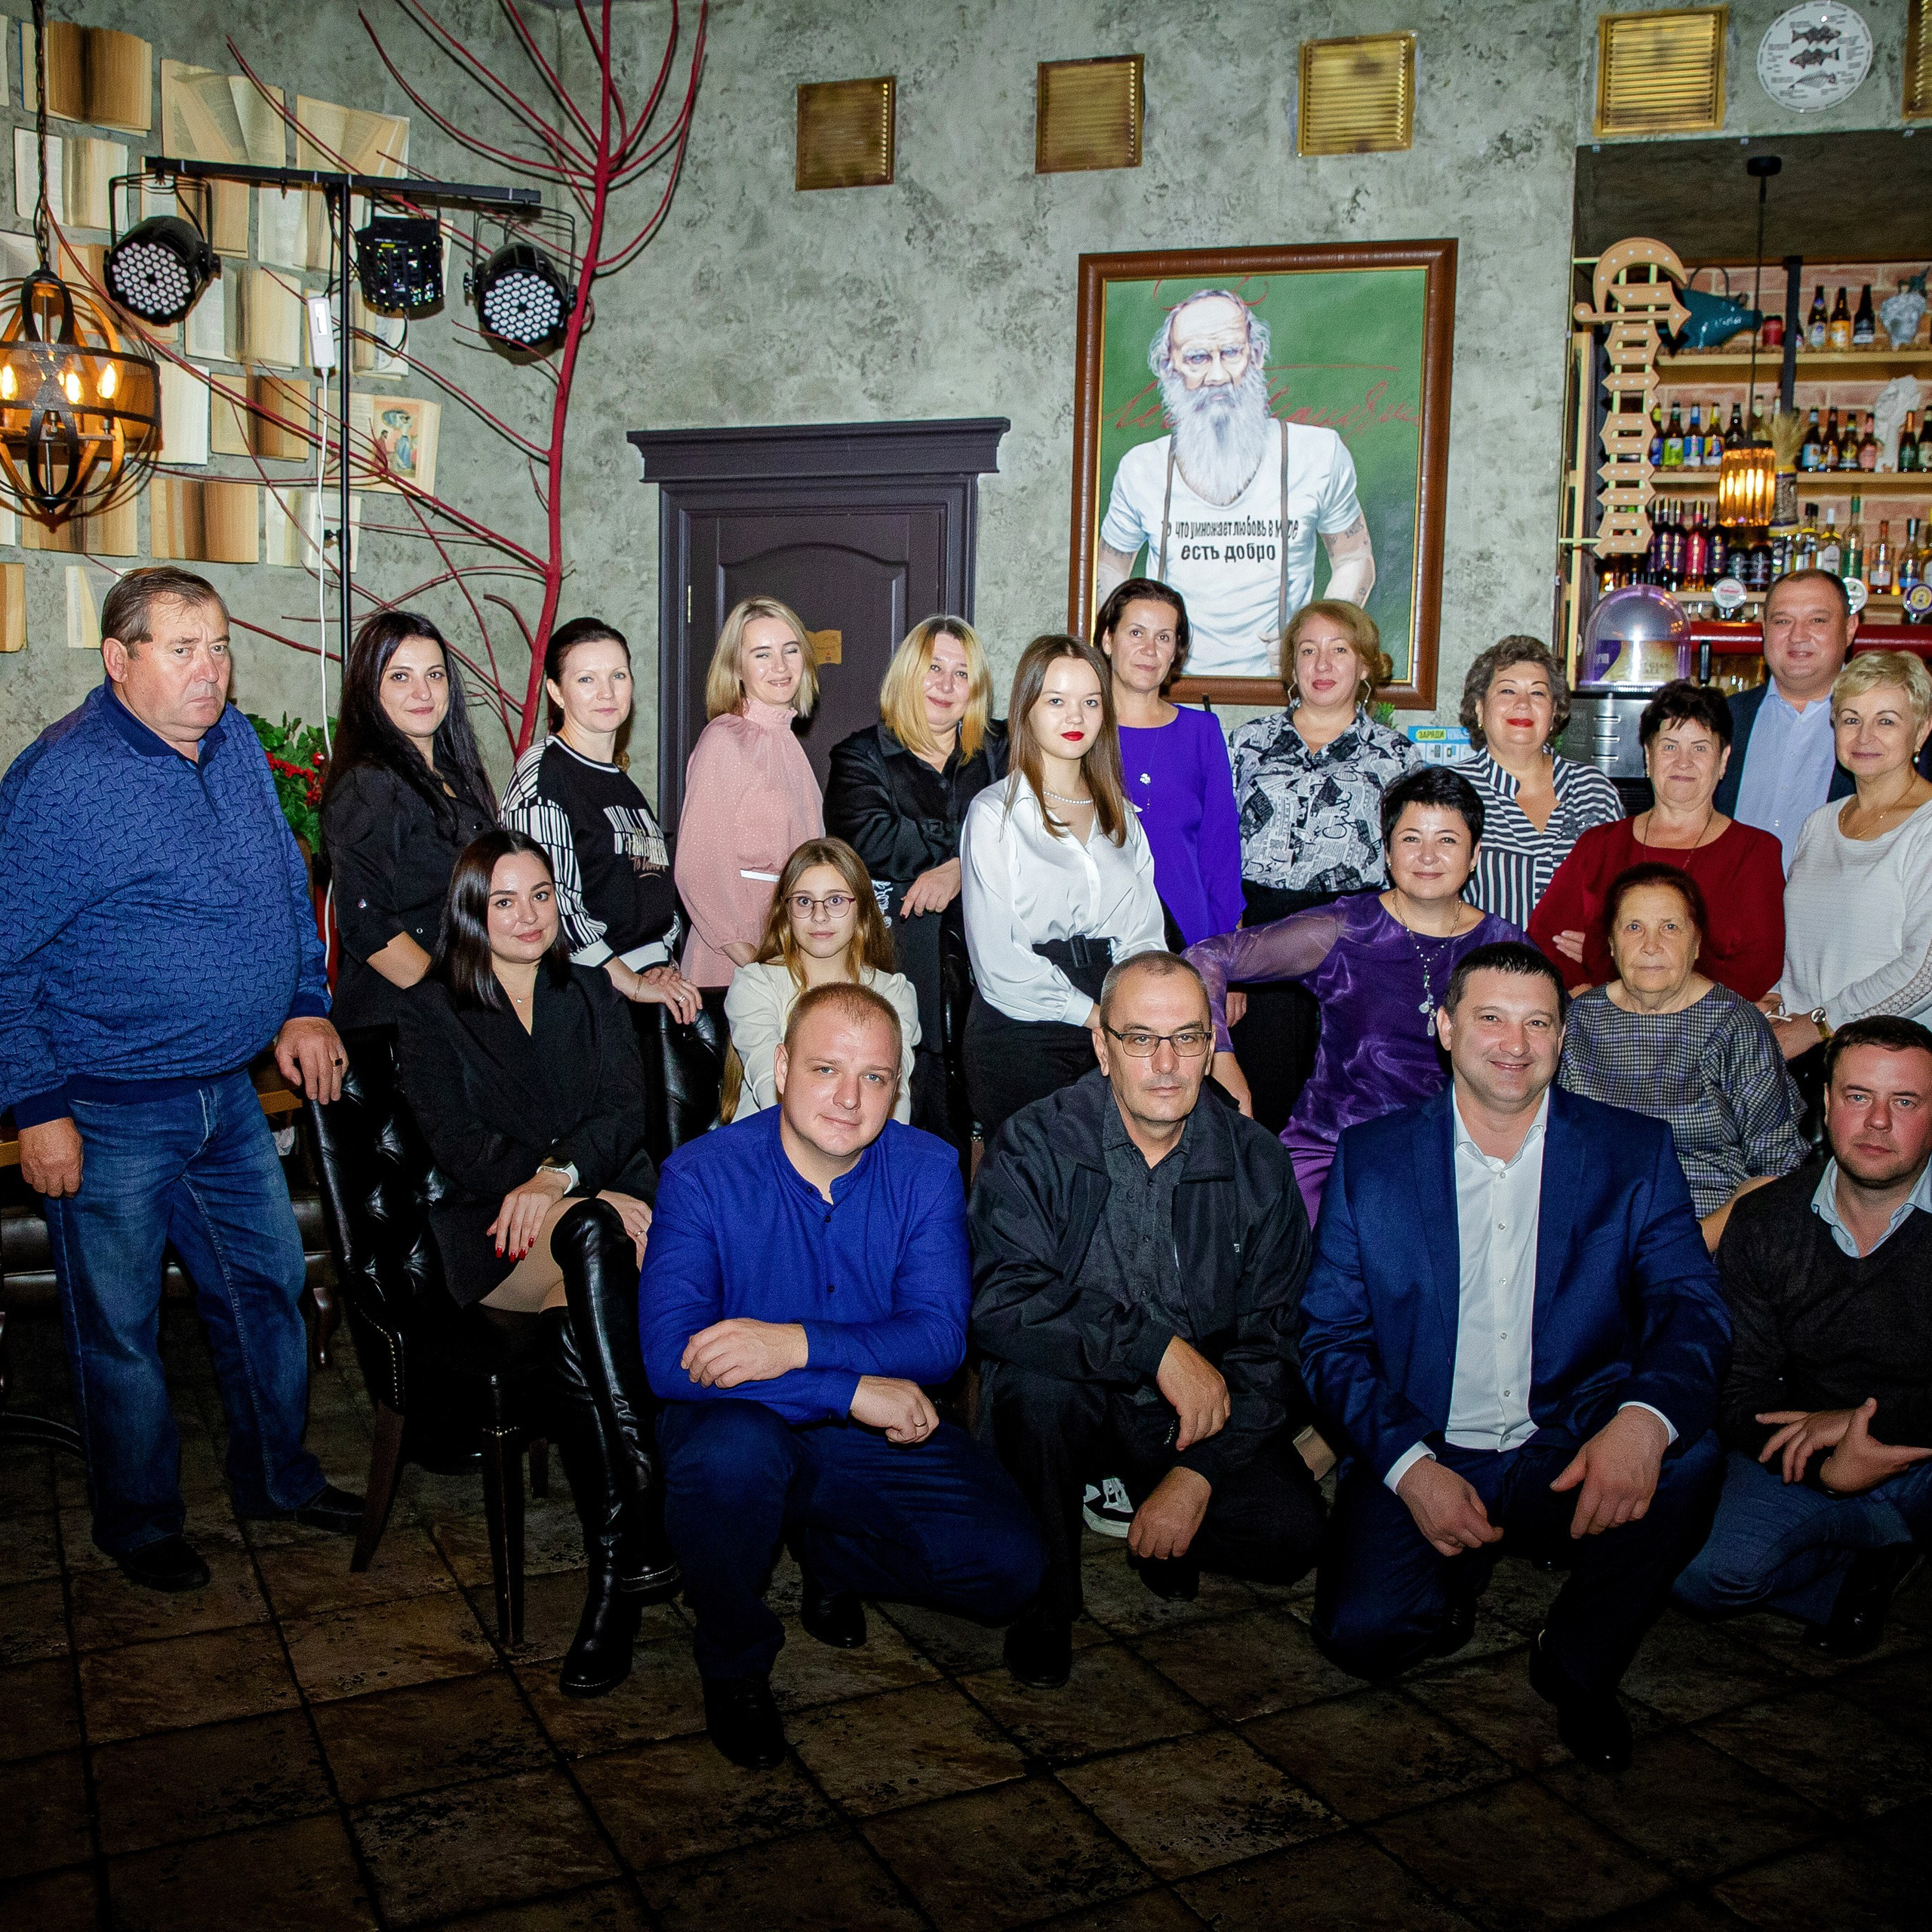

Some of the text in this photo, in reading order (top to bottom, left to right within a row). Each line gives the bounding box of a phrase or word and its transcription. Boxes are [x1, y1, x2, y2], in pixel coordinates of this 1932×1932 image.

[1574, 237, 1691, 559] Corona
[1175, 521, 1189, 538] что
[1190, 521, 1232, 540] умножает
[1233, 515, 1266, 536] любовь
[1269, 520, 1273, 537] в
[1181, 543, 1275, 563] есть добро
